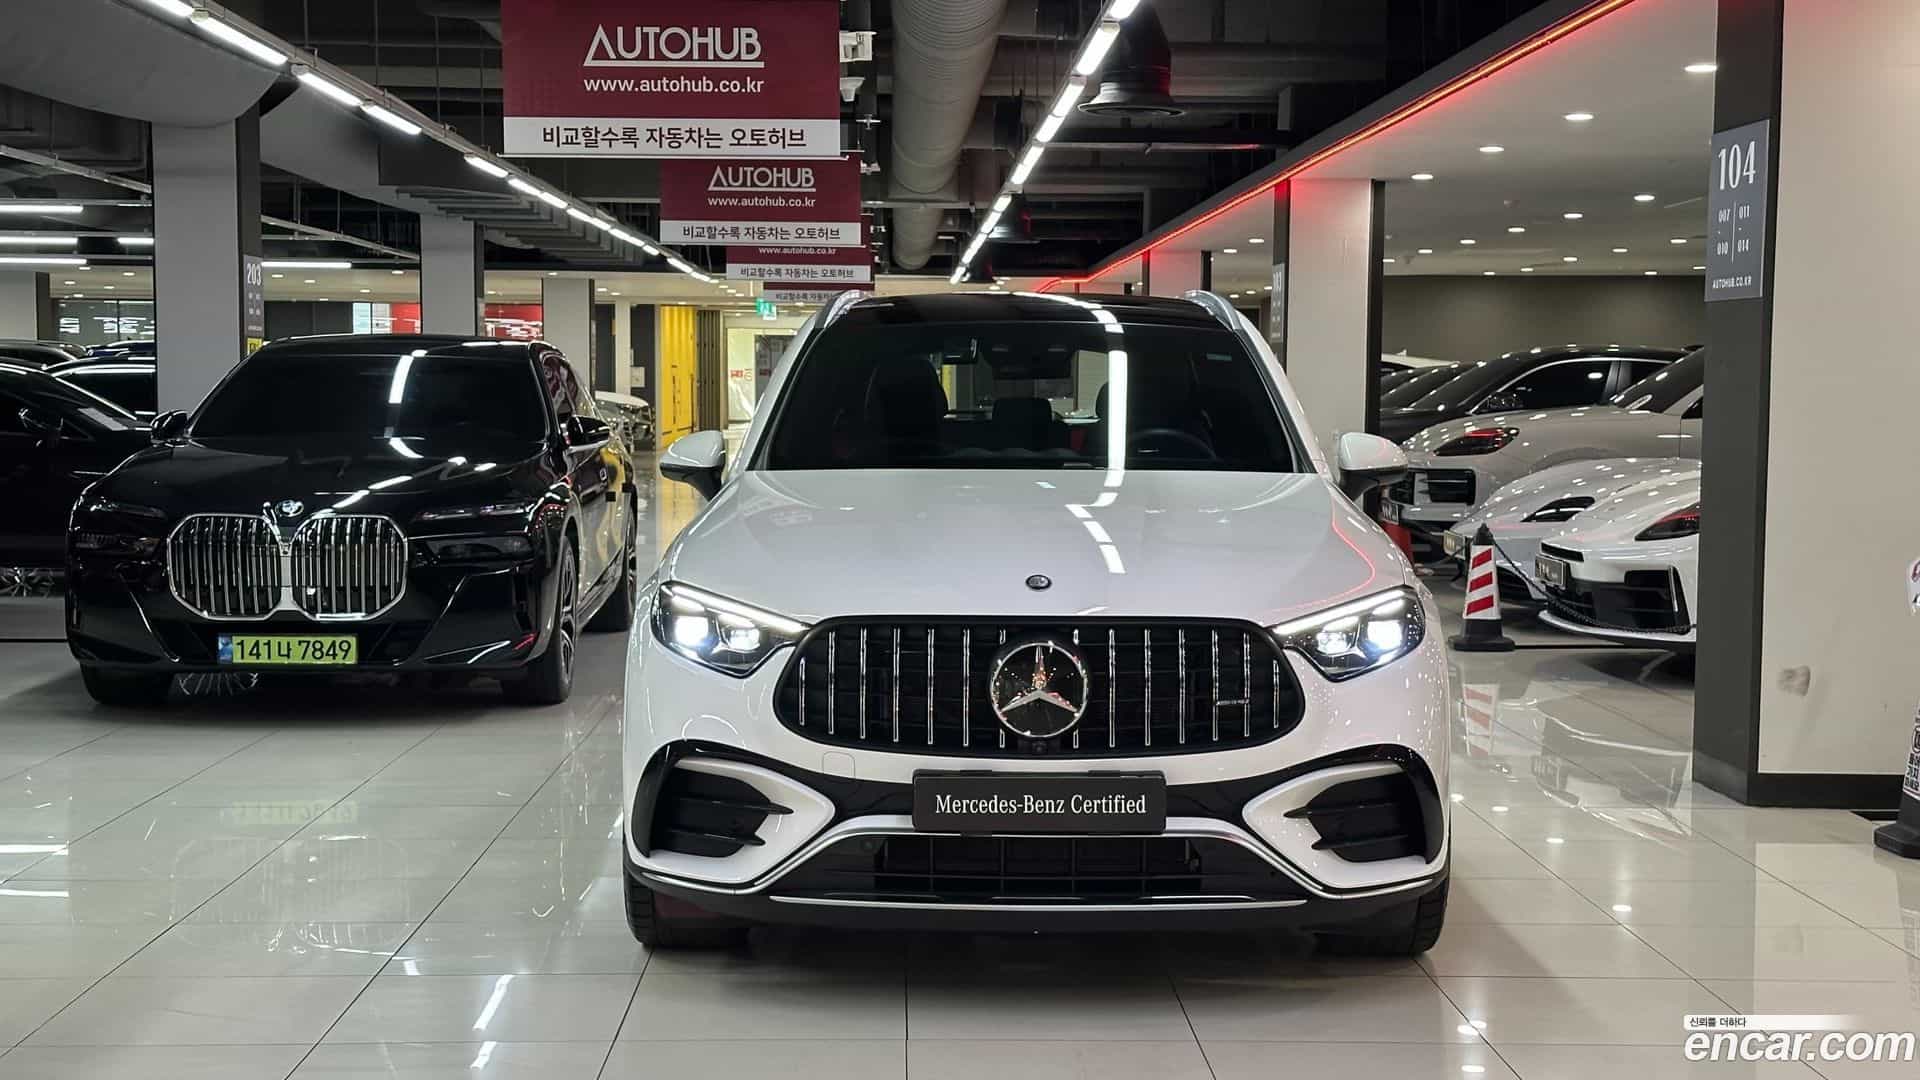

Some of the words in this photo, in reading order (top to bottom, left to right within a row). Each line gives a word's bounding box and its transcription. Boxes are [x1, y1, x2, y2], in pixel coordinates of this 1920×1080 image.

[583, 23, 765, 67] AUTOHUB
[583, 76, 764, 94] www.autohub.co.kr
[542, 126, 639, 149] 비교할수록
[645, 126, 723, 149] 자동차는
[729, 127, 807, 149] 오토허브
[1718, 141, 1756, 190] 104
[708, 165, 816, 192] AUTOHUB
[707, 195, 816, 208] www.autohub.co.kr
[682, 226, 741, 240] 비교할수록
[744, 226, 791, 240] 자동차는
[794, 227, 841, 240] 오토허브
[758, 247, 837, 255] www.autohub.co.kr
[247, 263, 262, 286] 203
[236, 640, 292, 660] 141나
[297, 640, 352, 660] 7849
[935, 794, 1065, 814] Mercedes-Benz
[1070, 794, 1147, 814] Certified
